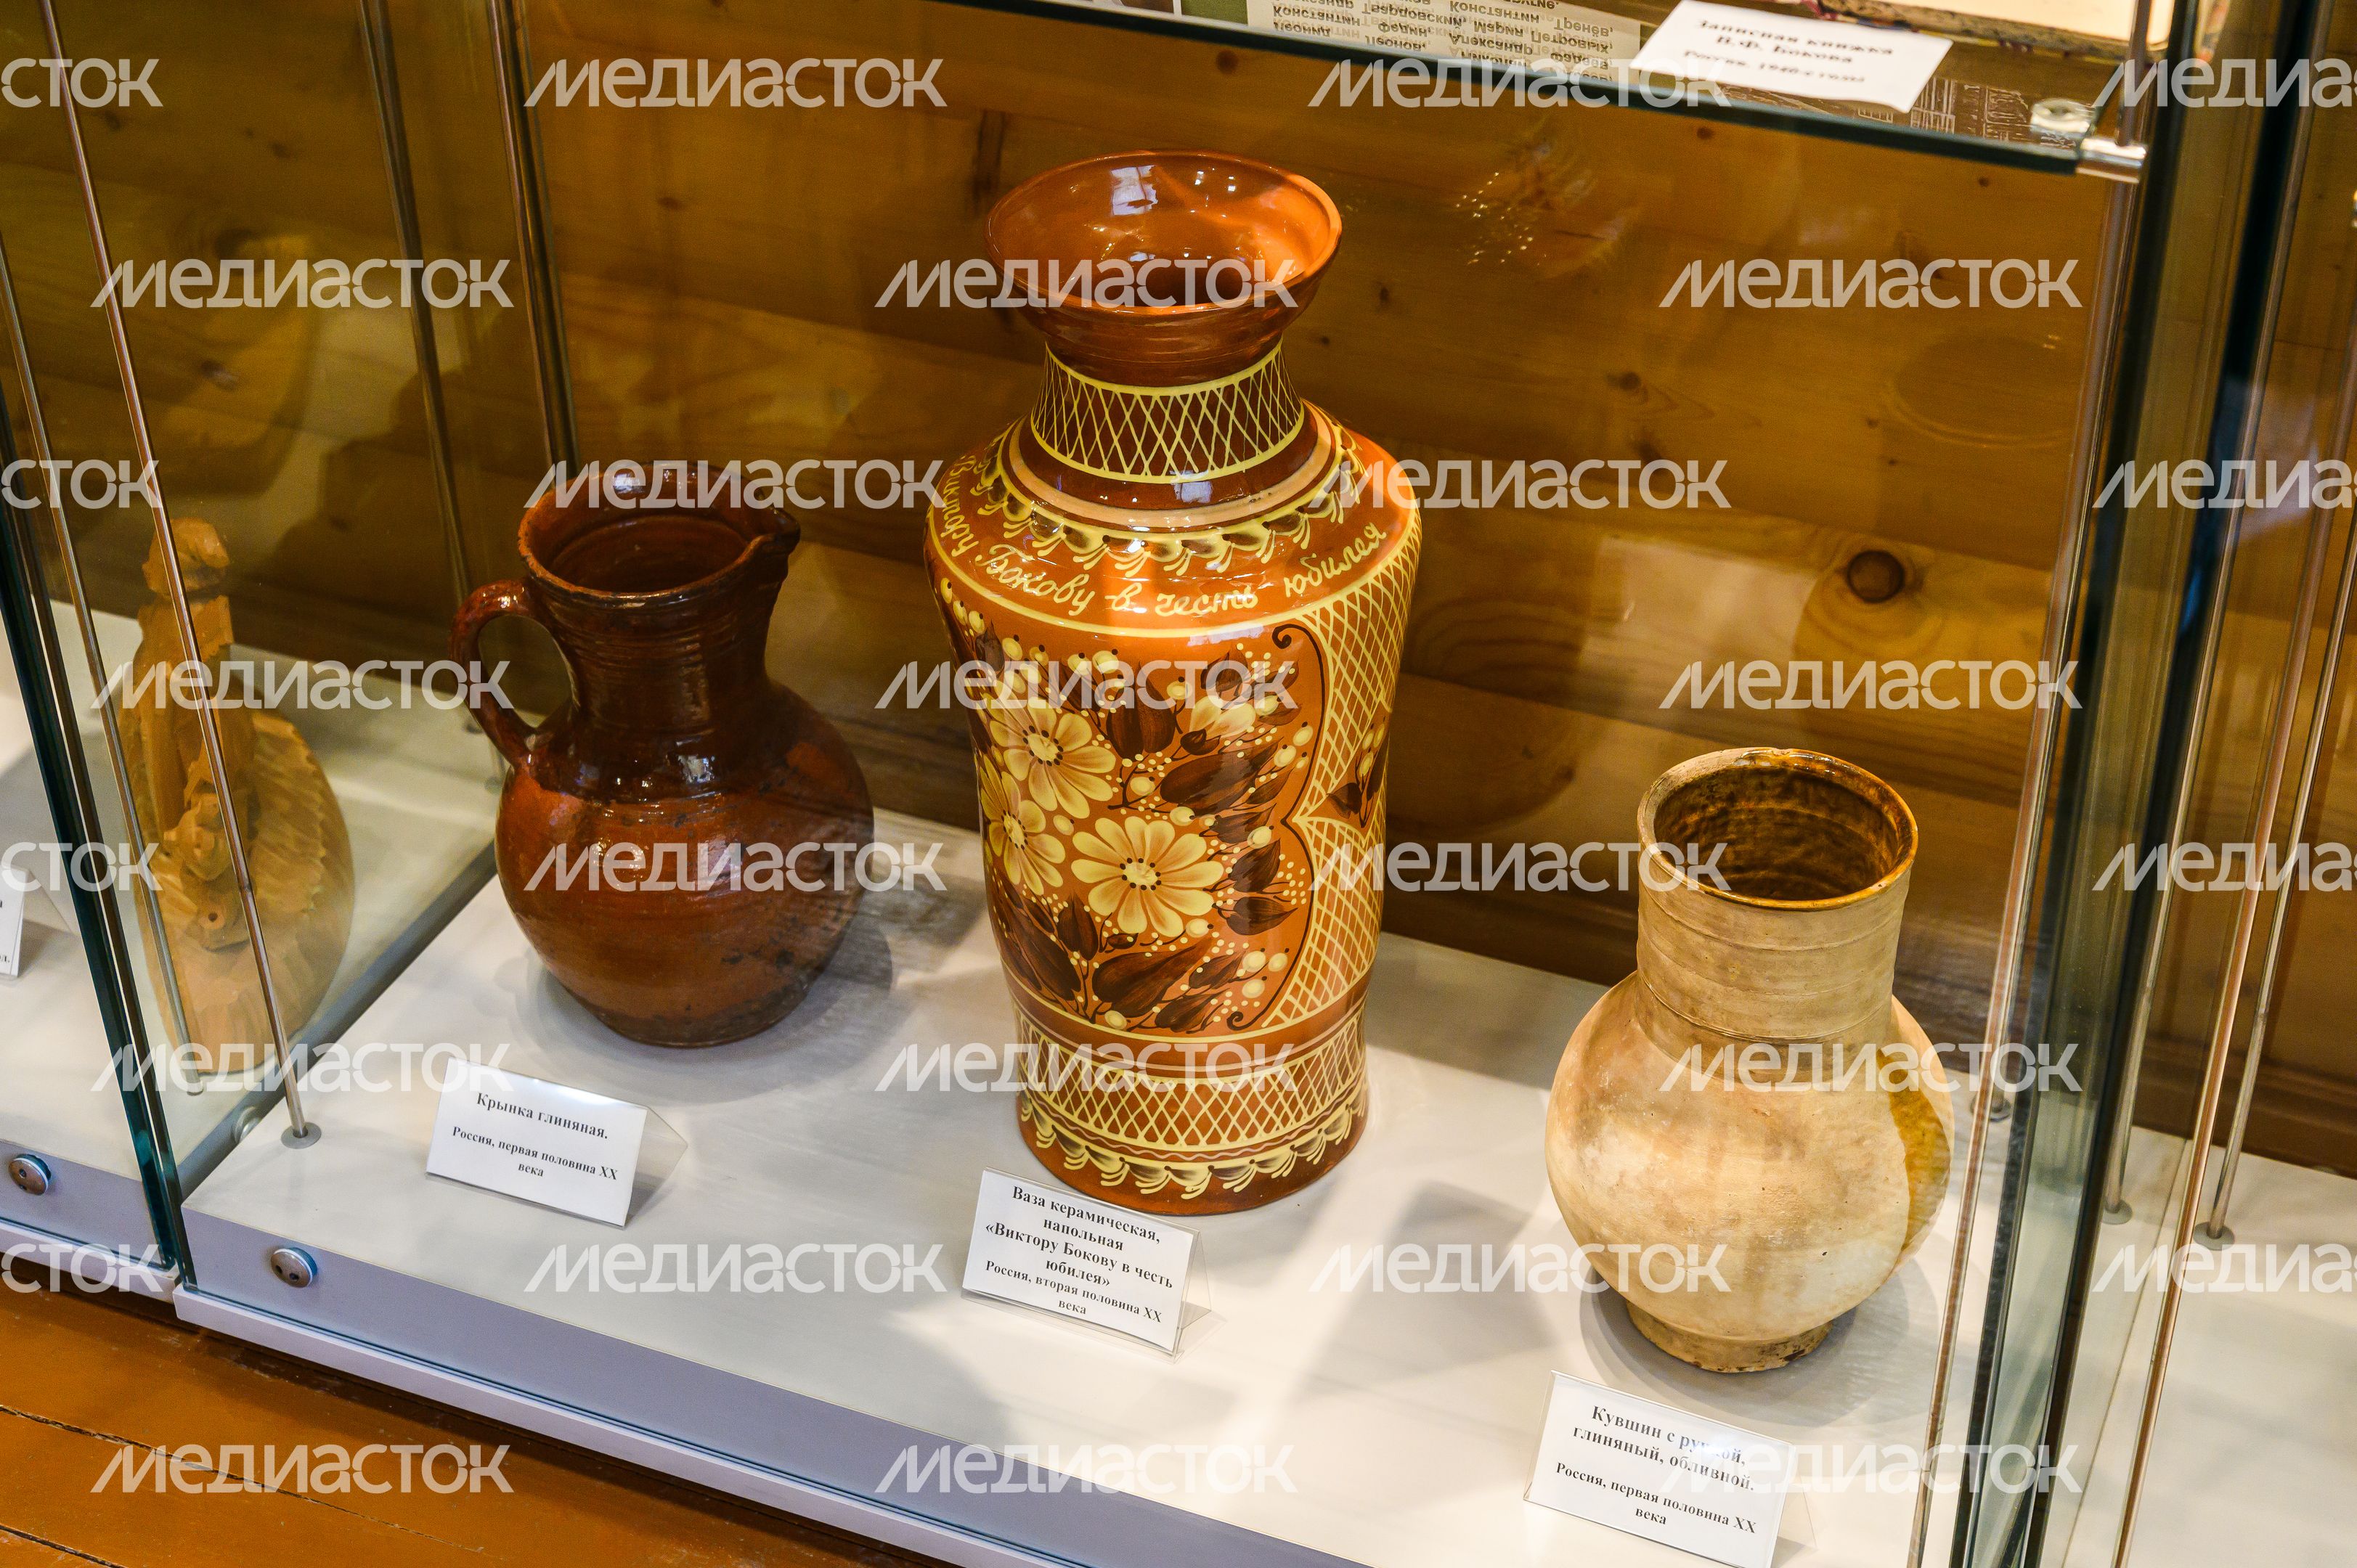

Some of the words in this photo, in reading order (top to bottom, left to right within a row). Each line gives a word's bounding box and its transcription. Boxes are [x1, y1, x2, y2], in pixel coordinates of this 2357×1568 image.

[476, 1093, 534, 1119] Крынка
[538, 1111, 608, 1139] глиняная.
[452, 1126, 495, 1147] Россия,
[498, 1140, 538, 1159] первая
[541, 1151, 596, 1175] половина
[518, 1163, 544, 1177] века
[1012, 1185, 1045, 1207] Ваза
[1051, 1201, 1160, 1244] керамическая,
[1043, 1219, 1123, 1251] напольная
[985, 1222, 1059, 1252] «Виктору
[1063, 1243, 1118, 1271] Бокову
[1122, 1262, 1130, 1273] в
[1135, 1267, 1173, 1289] честь
[1046, 1259, 1110, 1286] юбилея»
[985, 1260, 1032, 1283] Россия,
[1035, 1275, 1078, 1296] вторая
[1082, 1289, 1140, 1315] половина
[1058, 1299, 1087, 1315] века
[1573, 1426, 1664, 1464] глиняный,
[1669, 1453, 1754, 1491] обливной.
[1592, 1405, 1662, 1439] Кувшин
[1666, 1431, 1675, 1442] с
[1679, 1435, 1746, 1466] руой,
[1556, 1462, 1606, 1488] Россия,
[1610, 1481, 1658, 1503] первая
[1663, 1498, 1730, 1525] половина
[1635, 1506, 1666, 1525] века
